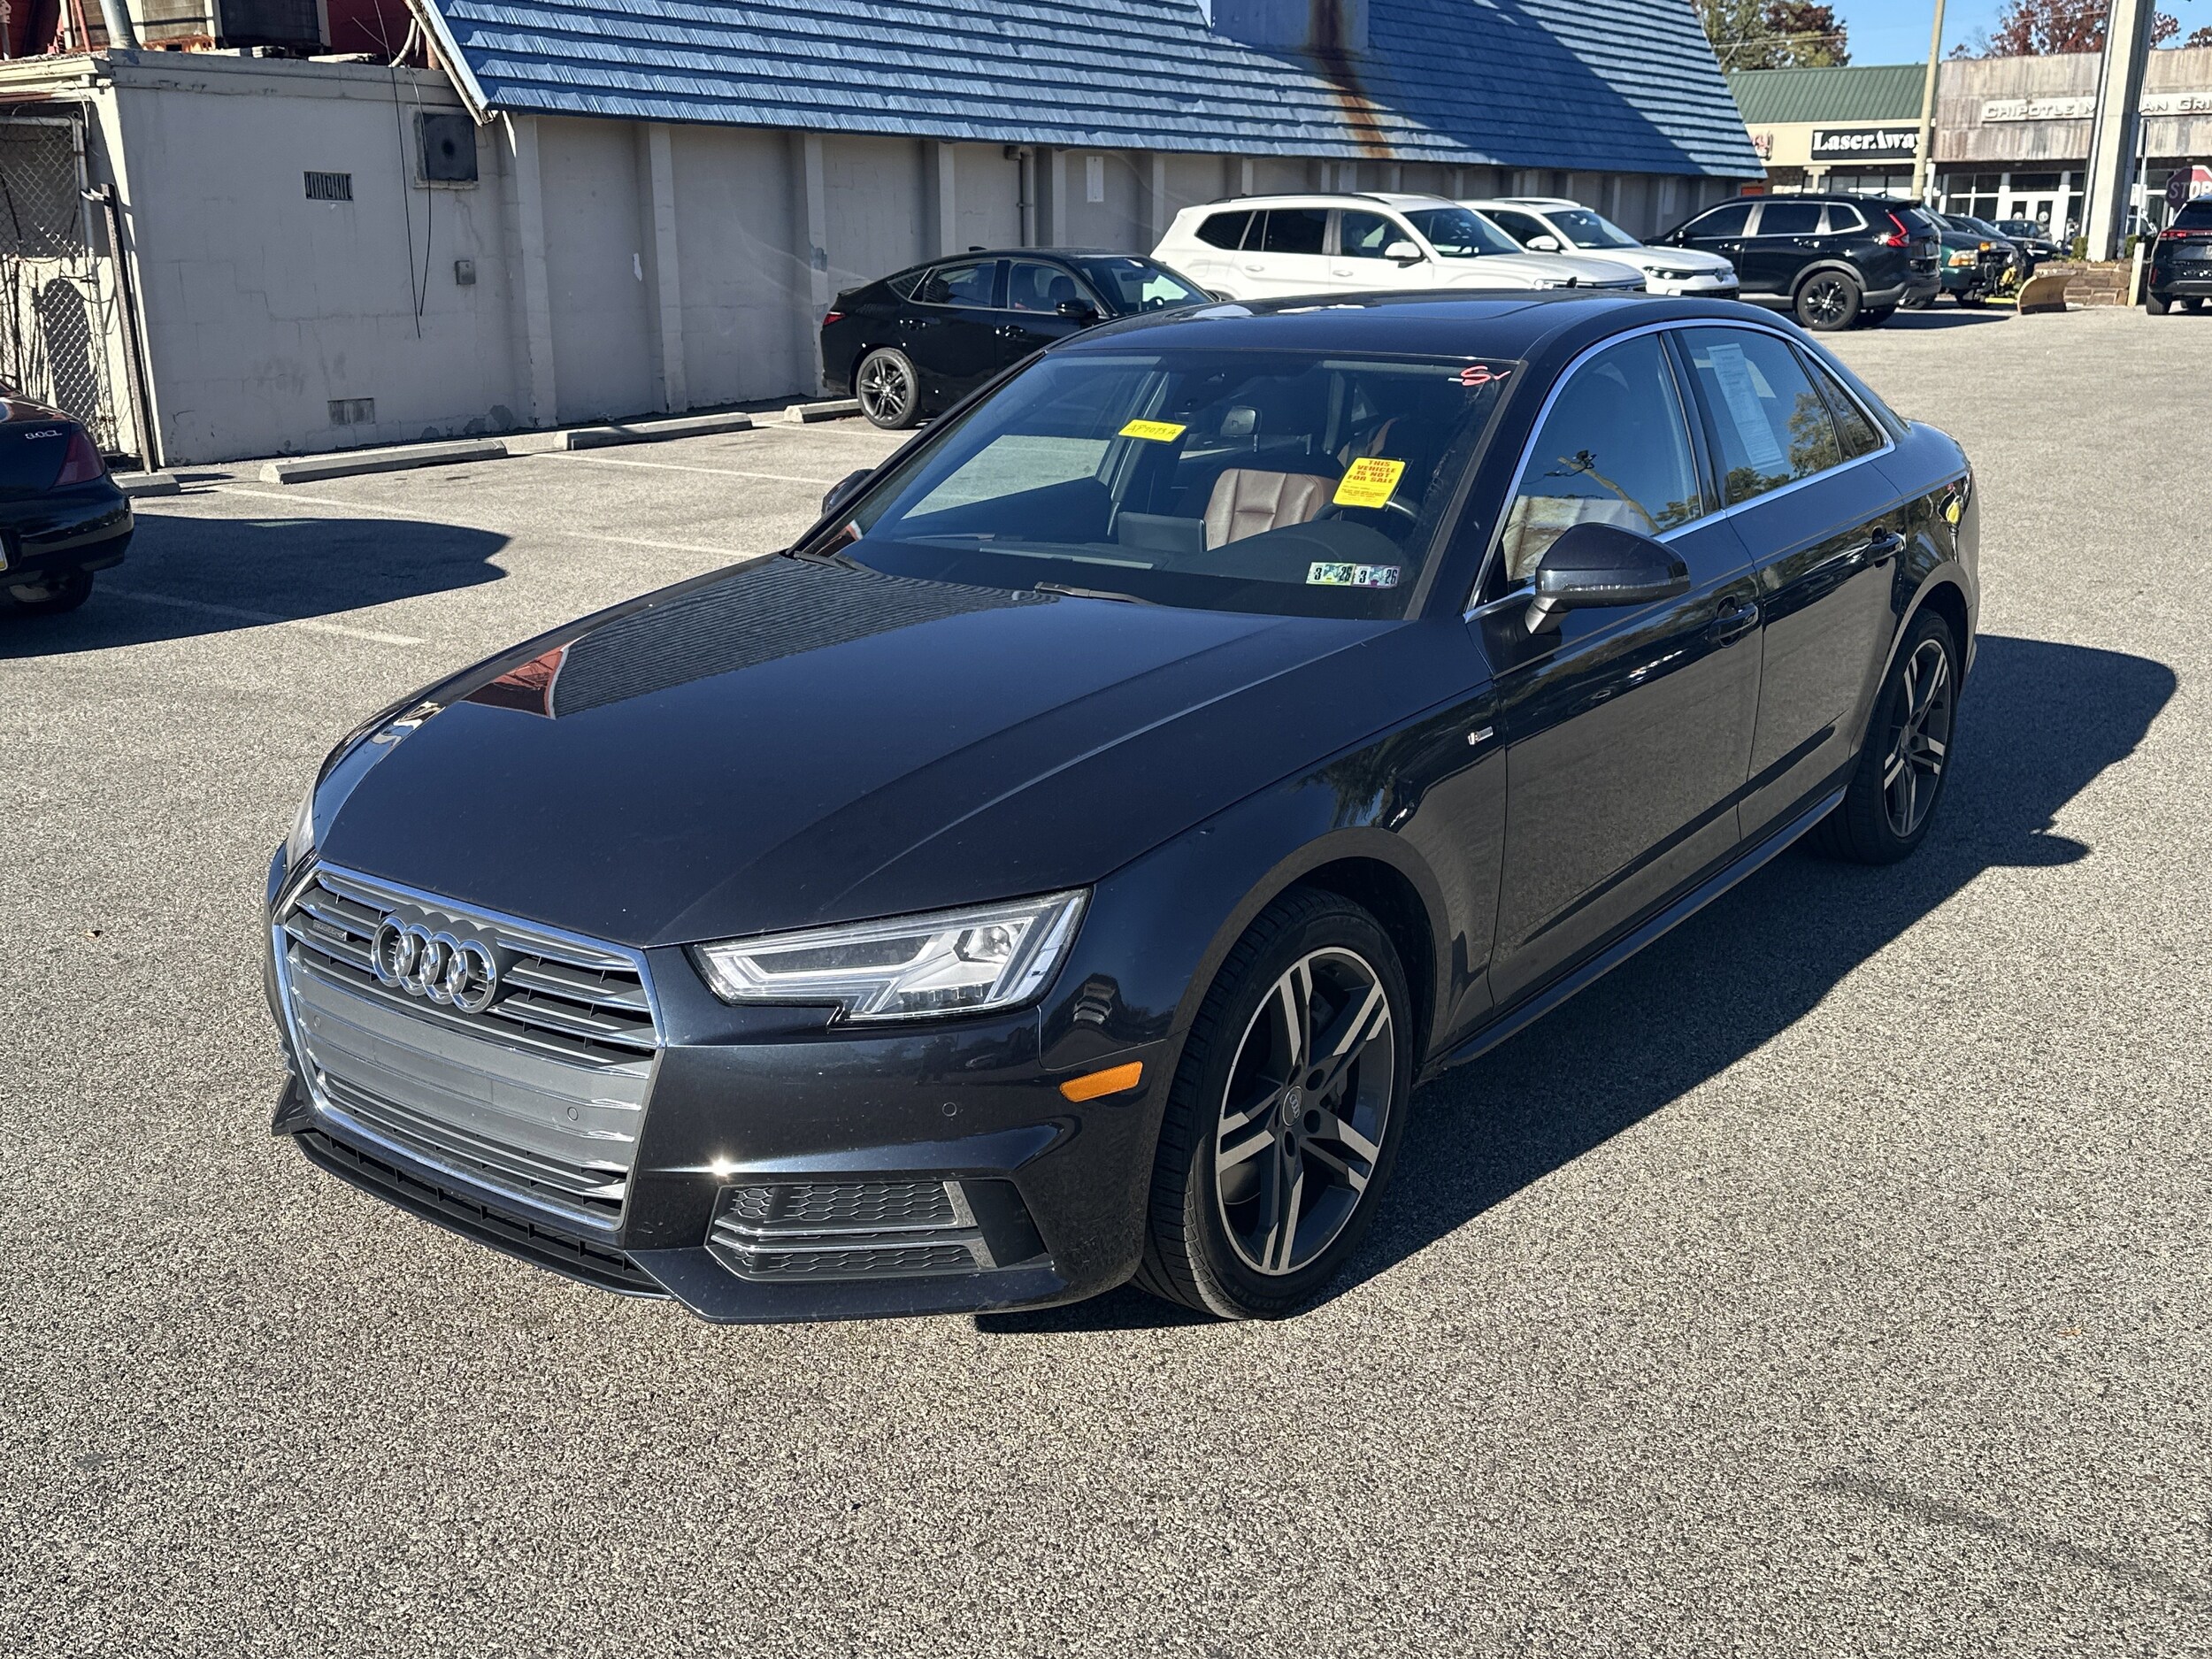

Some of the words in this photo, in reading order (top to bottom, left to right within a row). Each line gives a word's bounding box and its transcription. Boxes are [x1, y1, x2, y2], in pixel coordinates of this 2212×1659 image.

[1984, 103, 2076, 119] CHIPOTLE
[2169, 180, 2212, 199] STOP
[1314, 567, 1323, 580] 3
[1359, 570, 1367, 583] 3
[1386, 569, 1398, 584] 26
